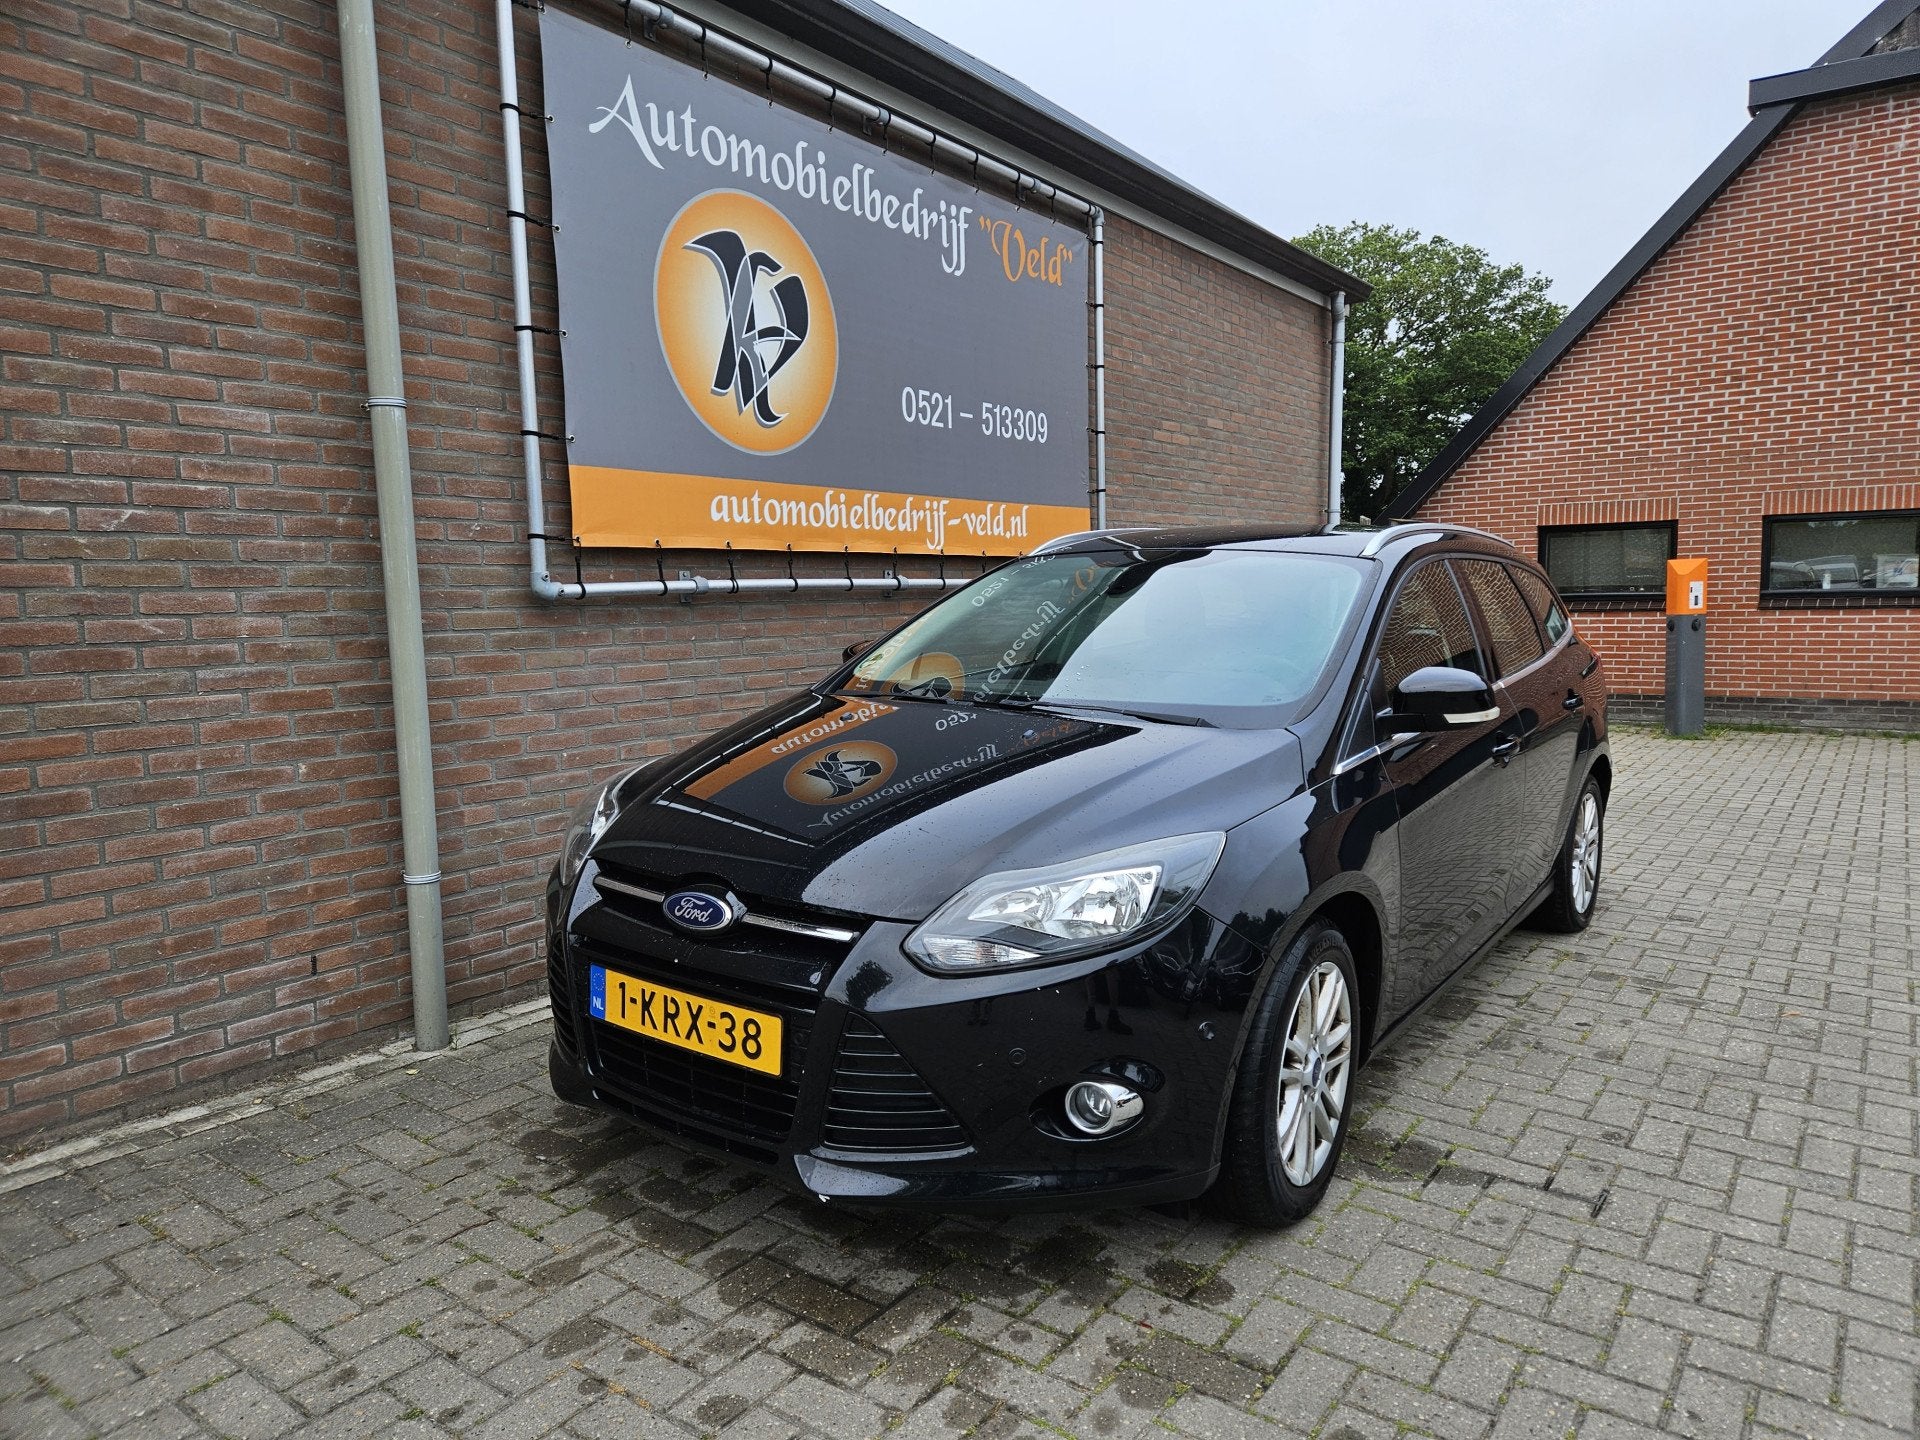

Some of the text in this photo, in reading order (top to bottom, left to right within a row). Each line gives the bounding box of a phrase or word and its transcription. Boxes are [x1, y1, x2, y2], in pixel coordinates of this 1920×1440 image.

[588, 73, 973, 277] Automobielbedrijf
[901, 386, 953, 429] 0521
[981, 401, 1048, 444] 513309
[710, 489, 1029, 550] automobielbedrijf-veld.nl
[674, 896, 713, 923] Ford
[592, 995, 604, 1011] NL
[618, 981, 762, 1060] 1-KRX-38
